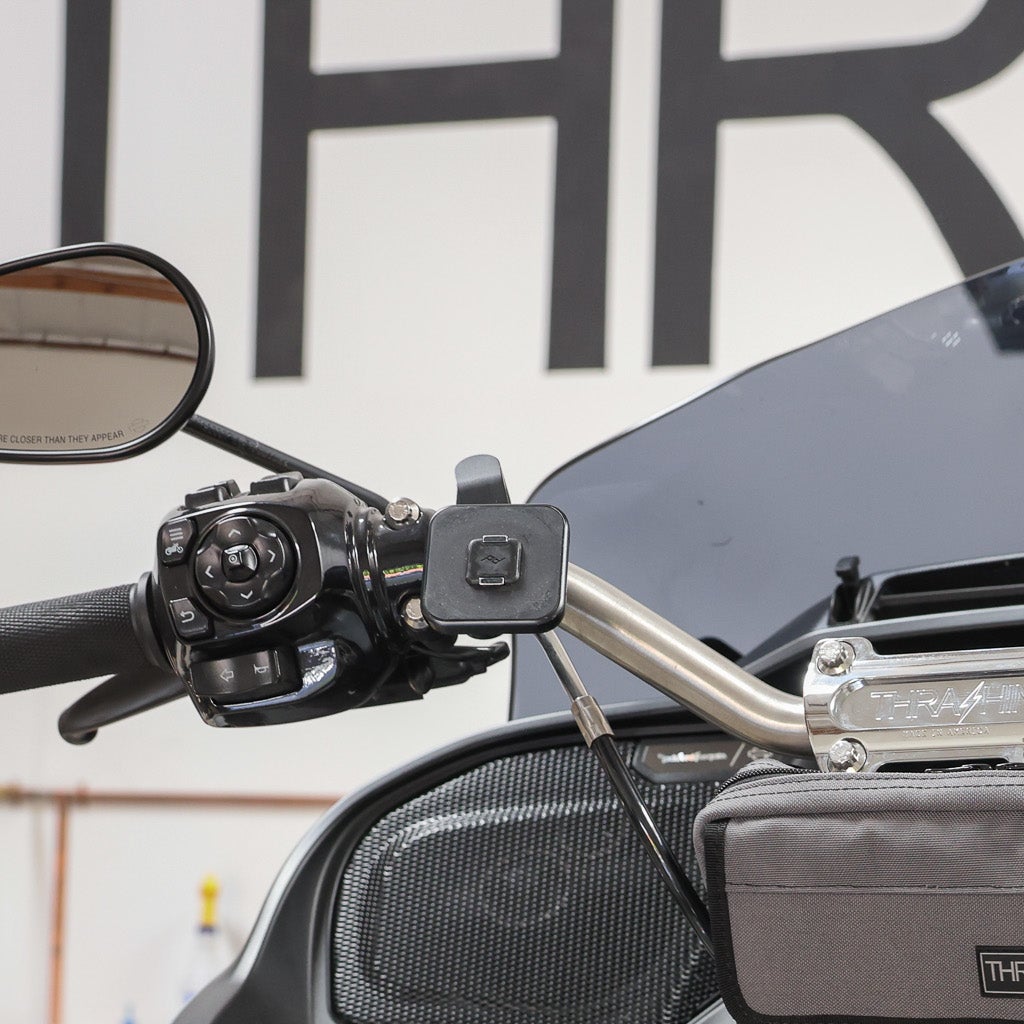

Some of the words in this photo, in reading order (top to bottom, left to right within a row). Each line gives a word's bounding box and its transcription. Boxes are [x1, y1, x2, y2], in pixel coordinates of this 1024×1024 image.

[9, 434, 43, 445] CLOSER
[45, 434, 66, 445] THAN
[68, 433, 89, 444] THEY
[91, 430, 125, 443] APPEAR
